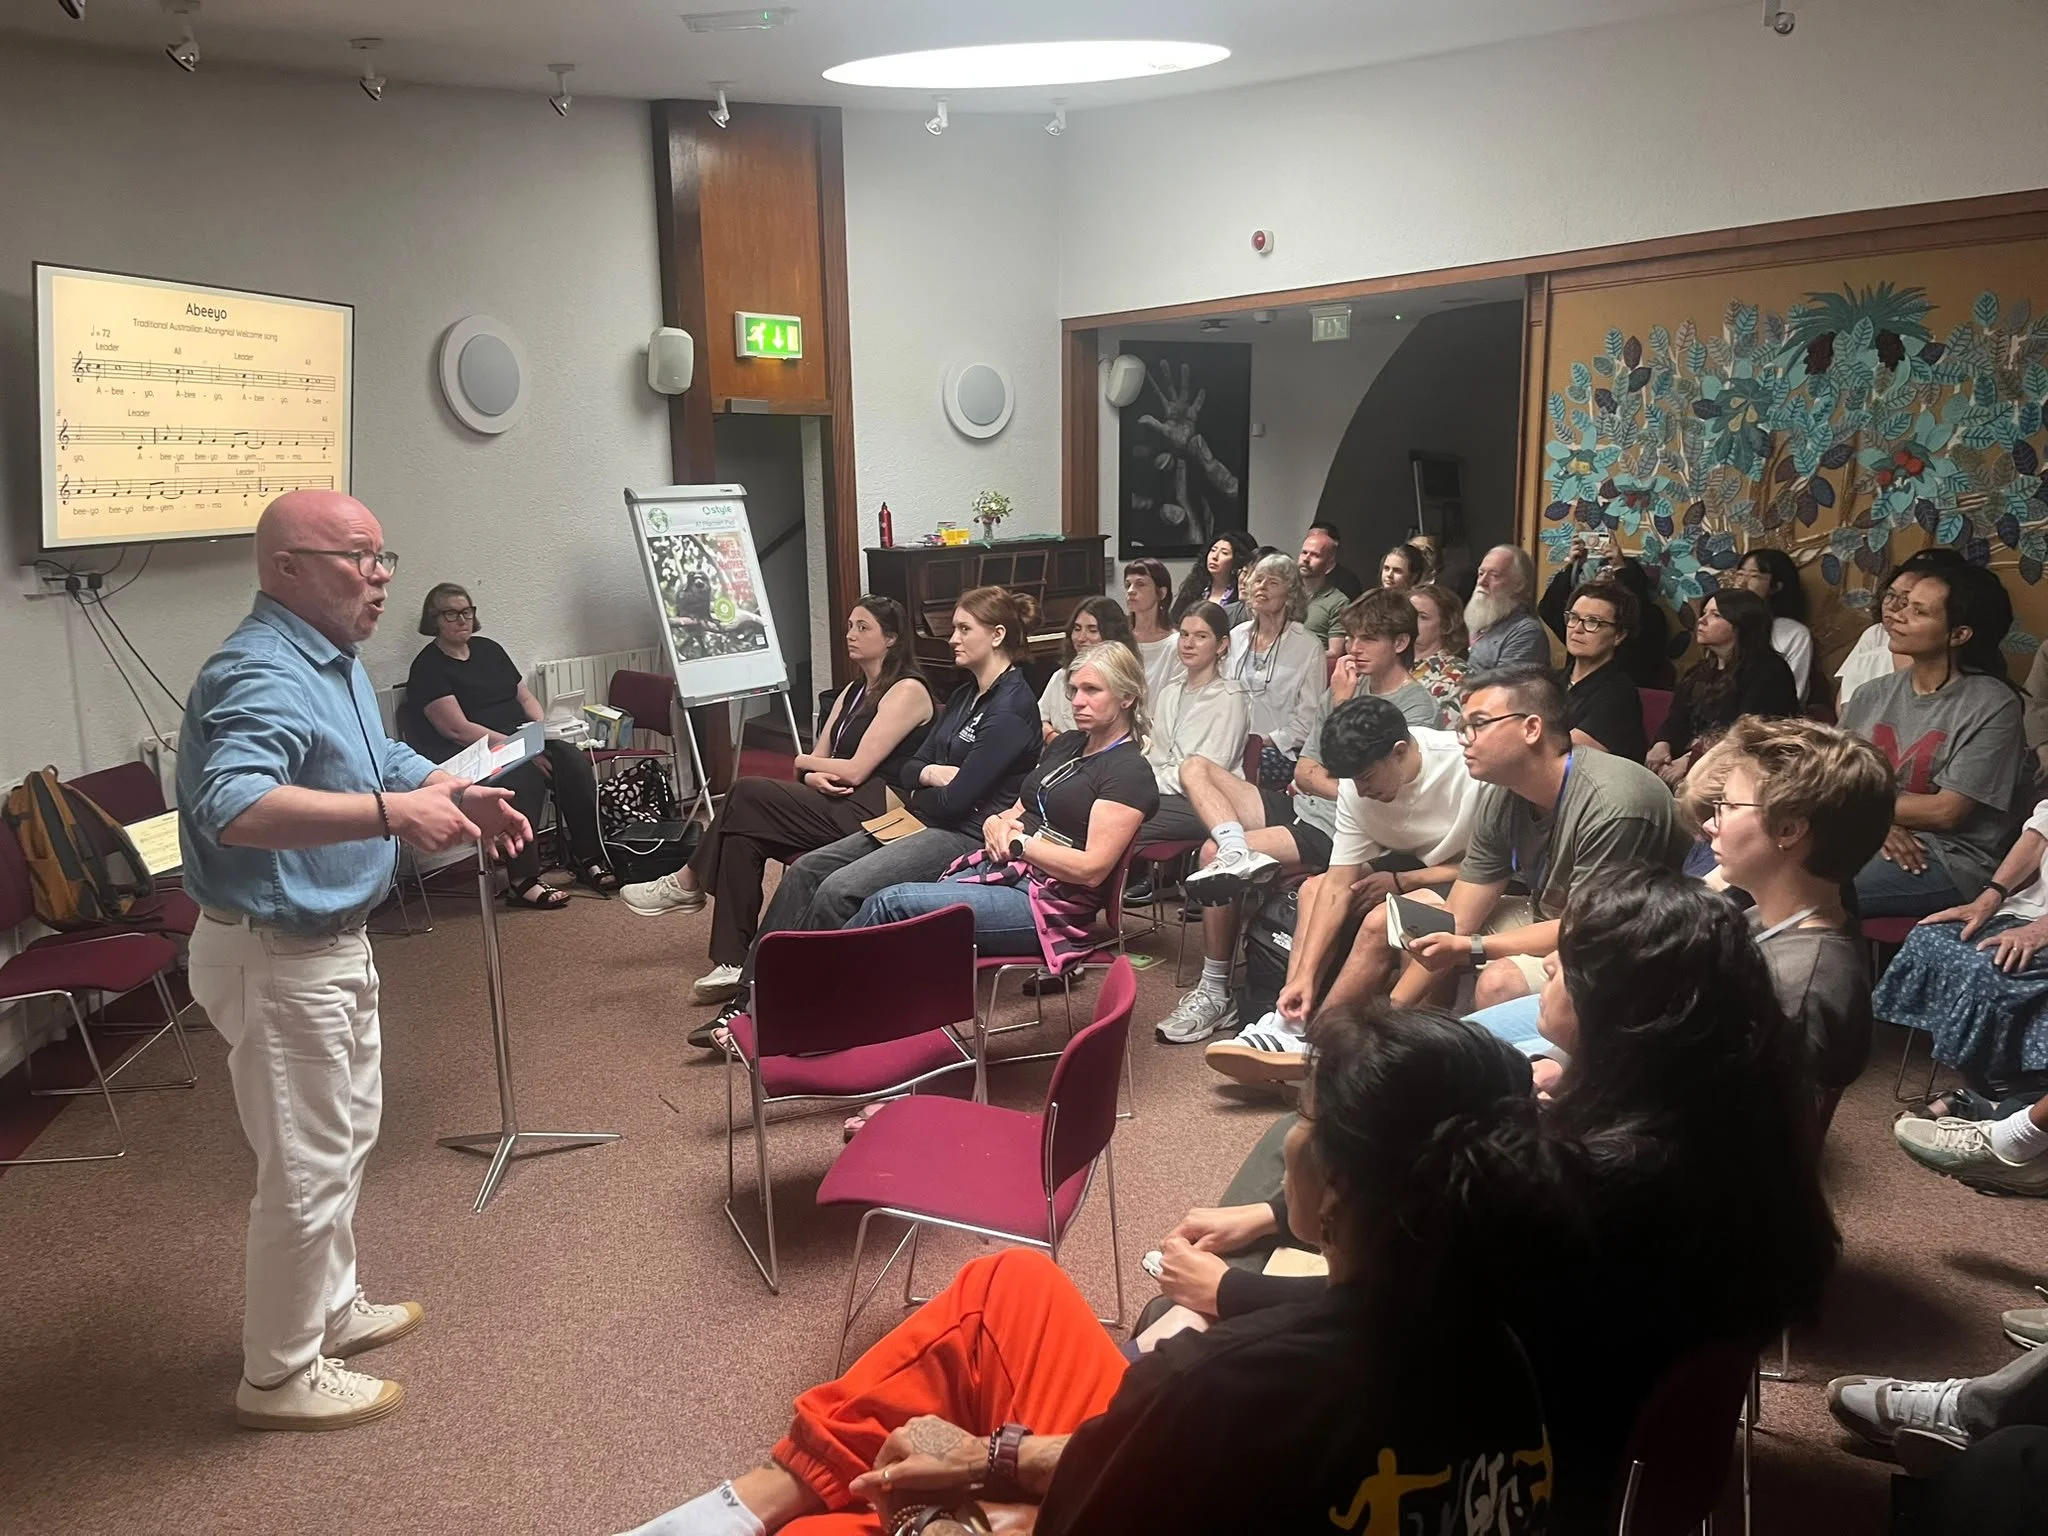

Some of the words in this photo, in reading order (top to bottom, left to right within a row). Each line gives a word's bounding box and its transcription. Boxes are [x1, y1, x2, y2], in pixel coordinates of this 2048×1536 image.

[185, 302, 228, 321] Abeeyo
[95, 342, 119, 351] Leader
[128, 409, 151, 417] Leader
[1872, 722, 1948, 794] M
